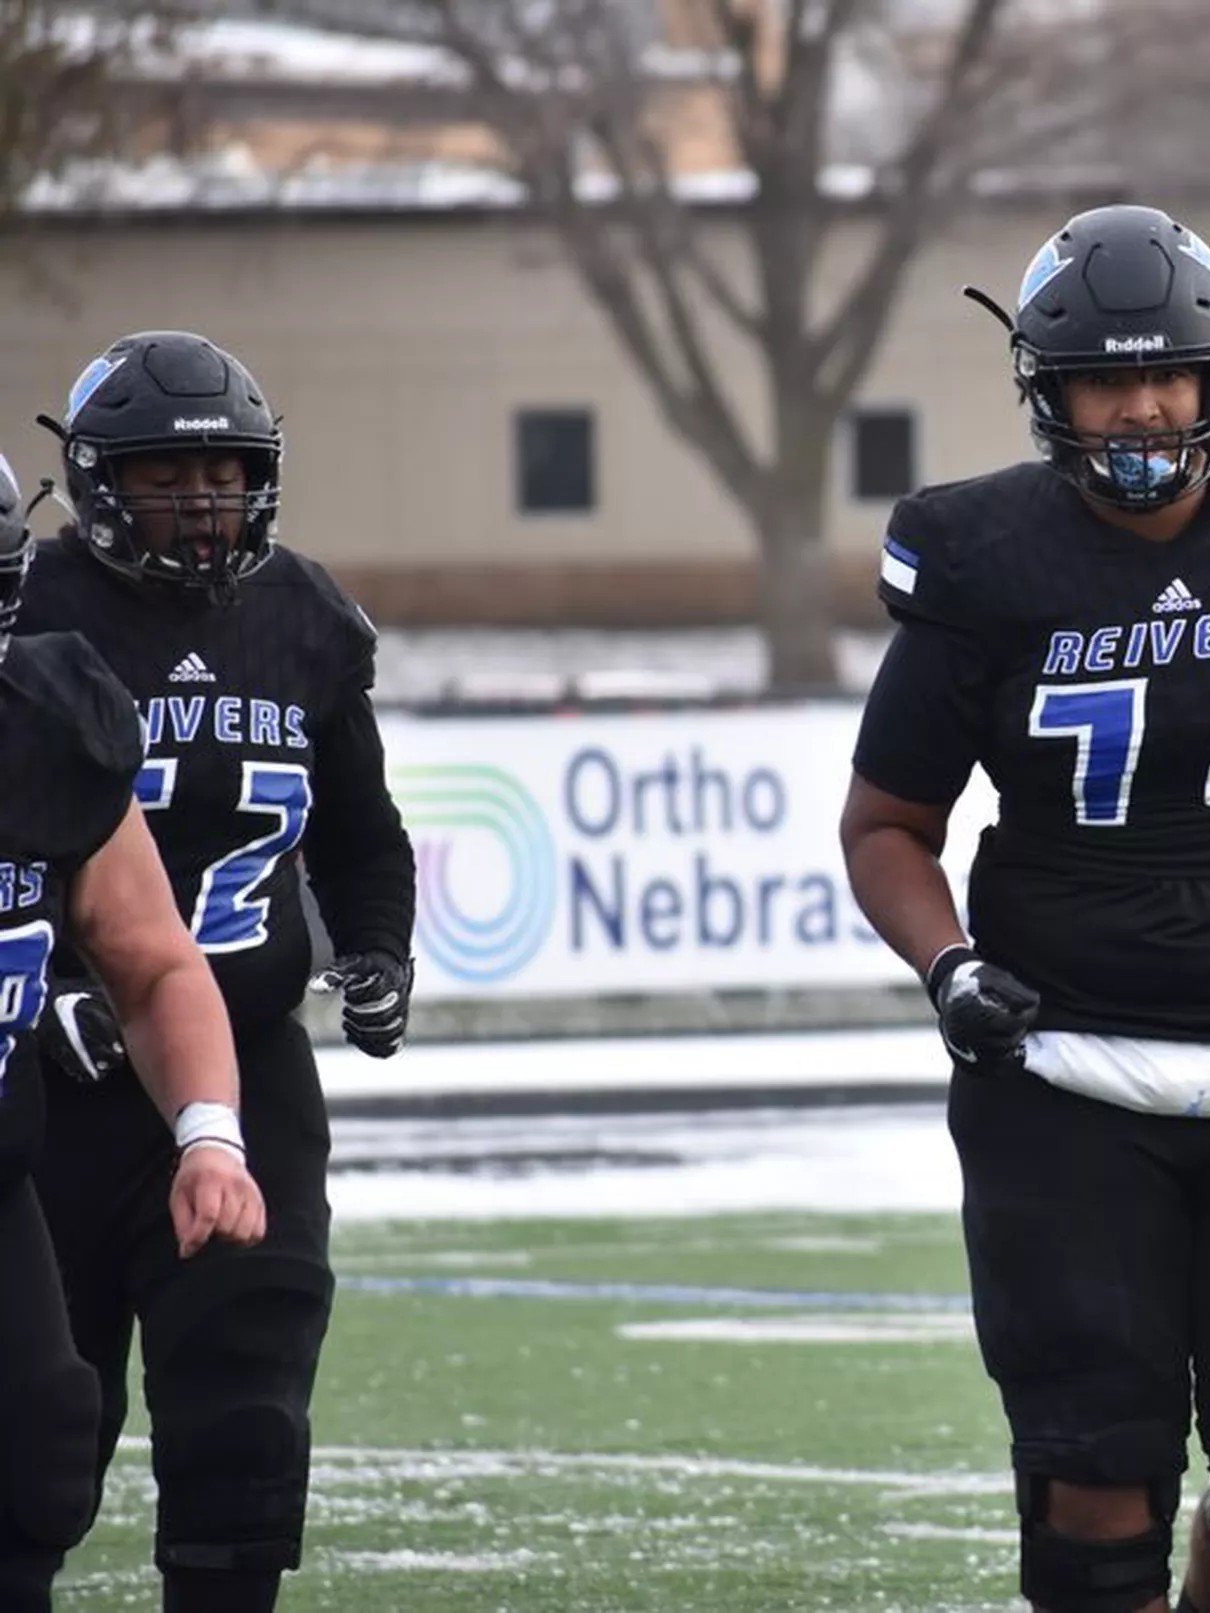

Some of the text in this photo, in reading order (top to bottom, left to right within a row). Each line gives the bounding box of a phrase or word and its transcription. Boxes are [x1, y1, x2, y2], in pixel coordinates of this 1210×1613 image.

[1105, 335, 1164, 352] Riddell
[1152, 598, 1202, 613] adidas
[134, 697, 309, 748] IVERS
[563, 744, 787, 840] Ortho
[566, 851, 880, 953] Nebra
